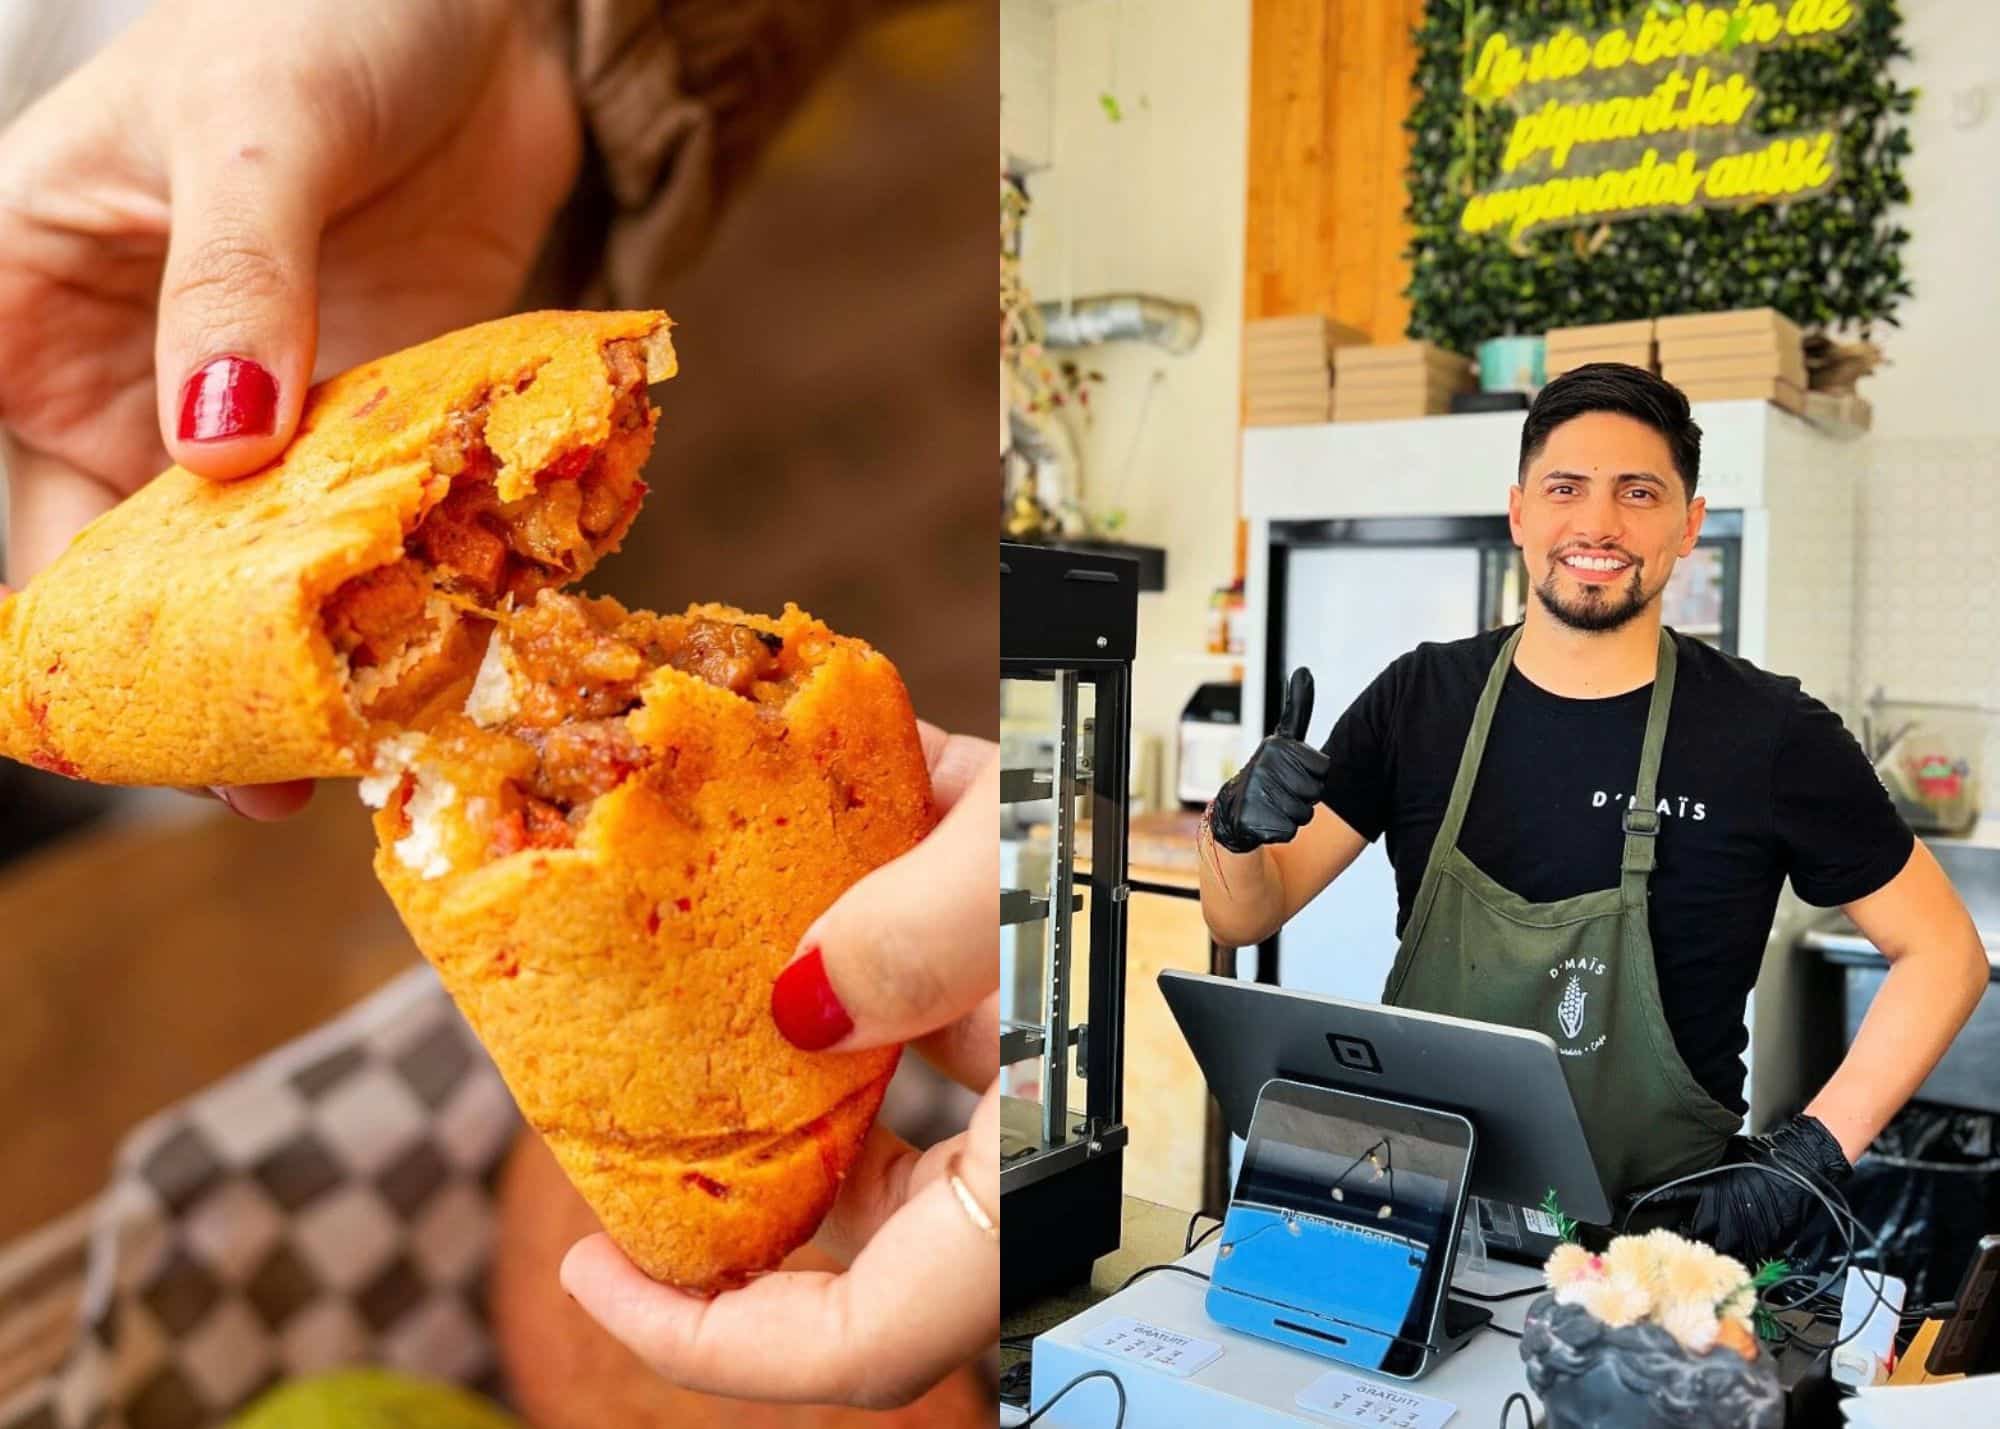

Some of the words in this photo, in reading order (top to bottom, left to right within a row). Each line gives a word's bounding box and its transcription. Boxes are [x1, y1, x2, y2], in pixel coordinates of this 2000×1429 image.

[1592, 28, 1632, 70] a
[1786, 0, 1854, 36] de
[1687, 66, 1756, 126] les
[1460, 148, 1707, 242] empanadas
[1705, 131, 1835, 197] aussi
